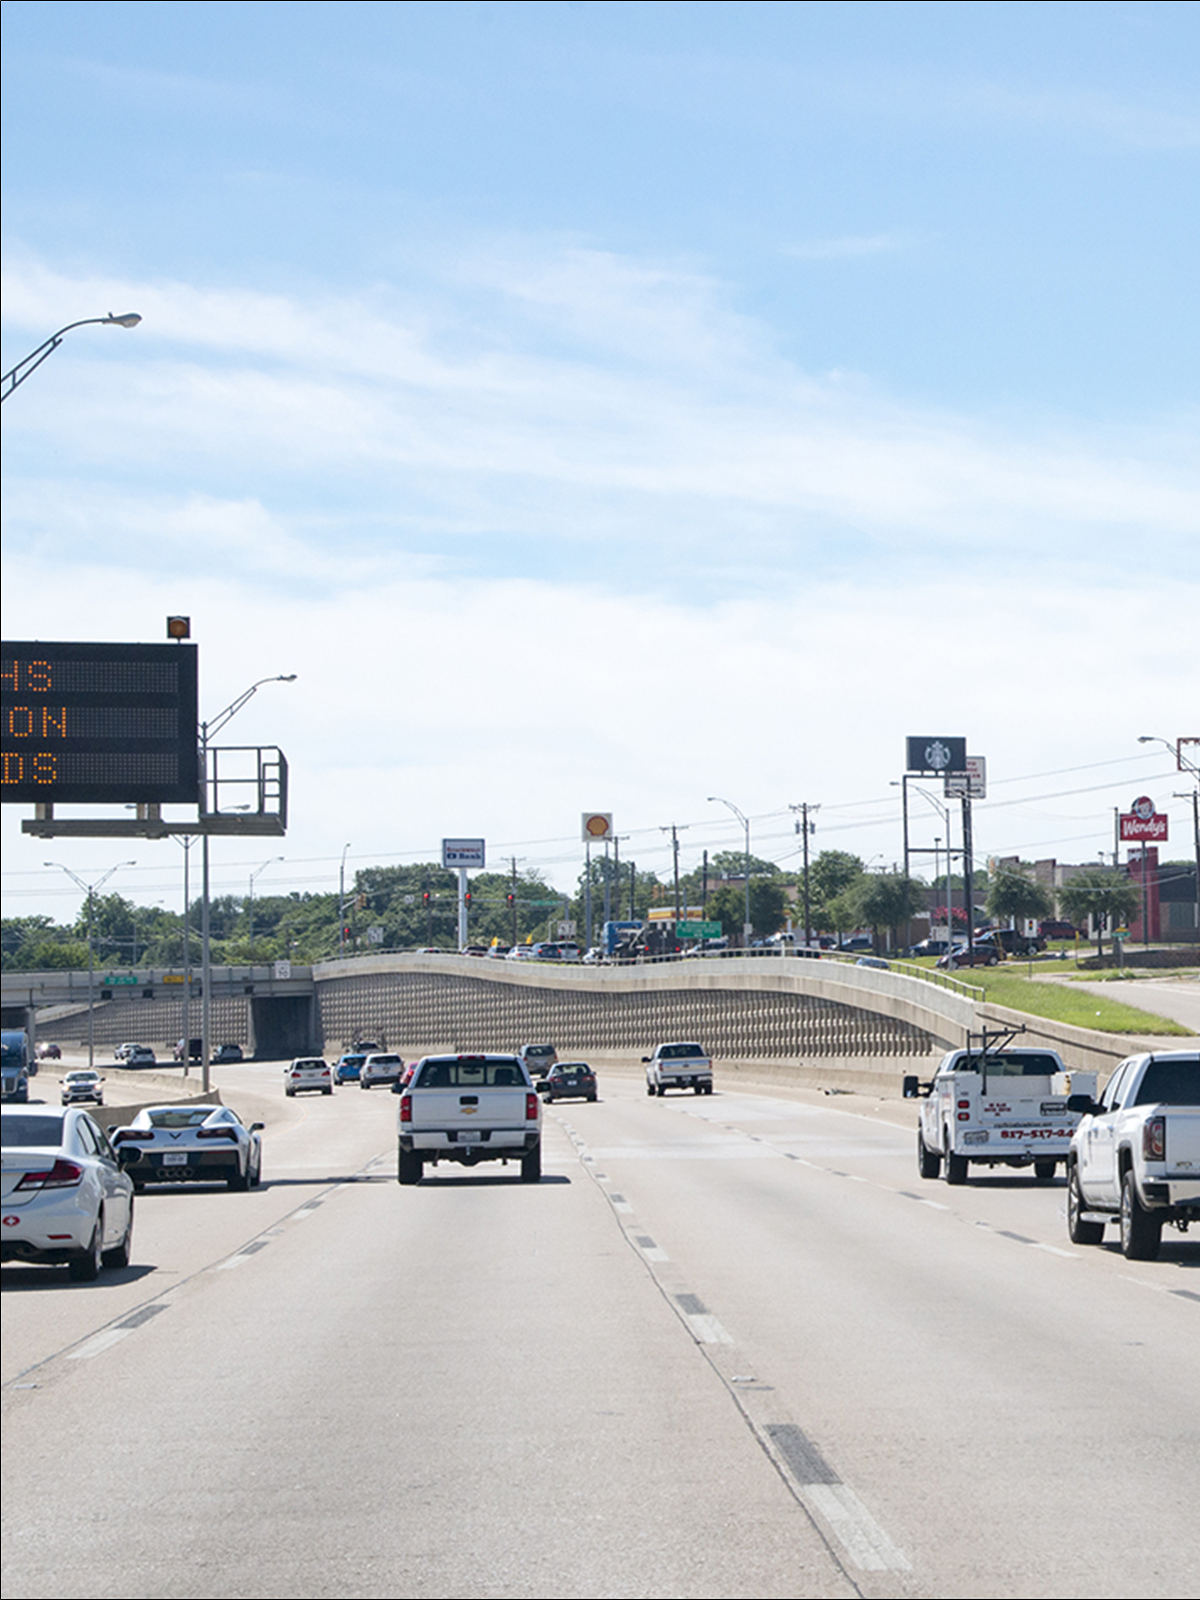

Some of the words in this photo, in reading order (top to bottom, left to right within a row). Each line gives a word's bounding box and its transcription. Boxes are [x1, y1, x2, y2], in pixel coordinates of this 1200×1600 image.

[9, 706, 67, 738] ON
[1123, 819, 1166, 837] Wendy's
[1001, 1129, 1079, 1140] 817-517-24
